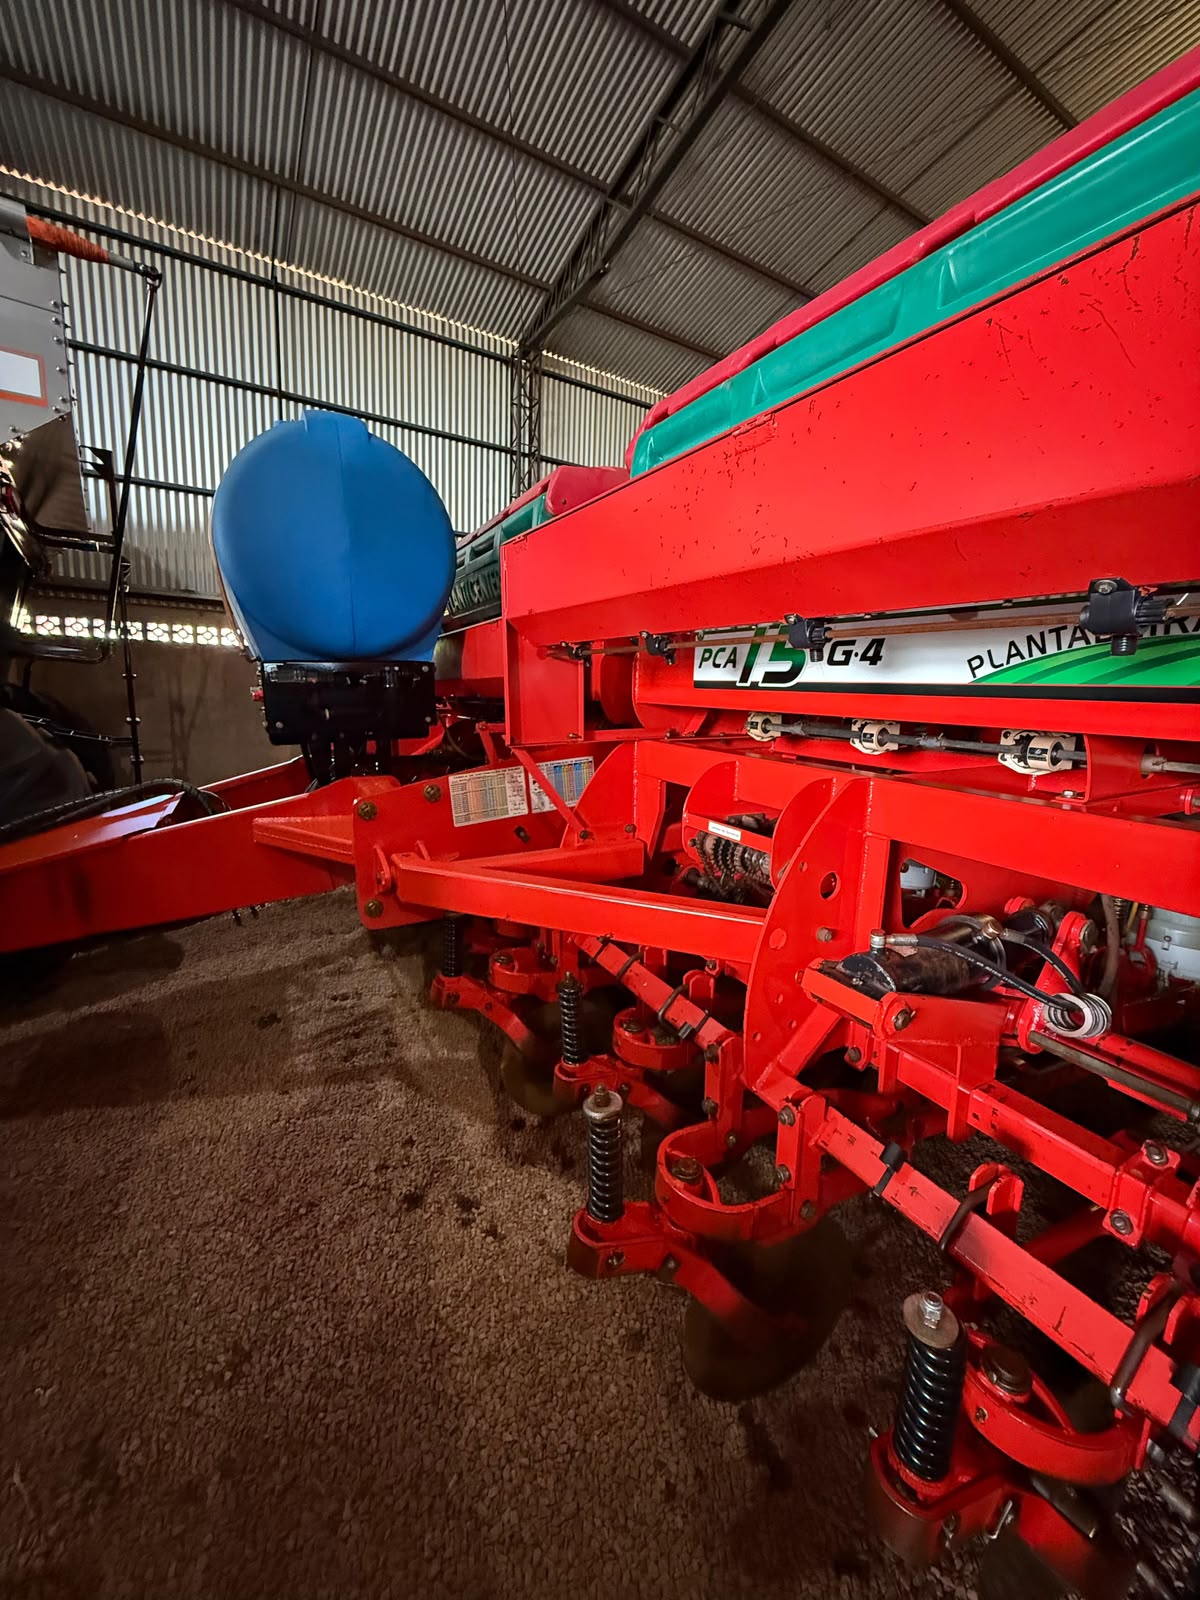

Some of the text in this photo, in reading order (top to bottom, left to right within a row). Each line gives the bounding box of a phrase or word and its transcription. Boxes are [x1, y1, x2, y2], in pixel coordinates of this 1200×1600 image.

[698, 646, 737, 669] PCA
[738, 625, 807, 686] 15
[966, 614, 1200, 679] PLANTAIR
